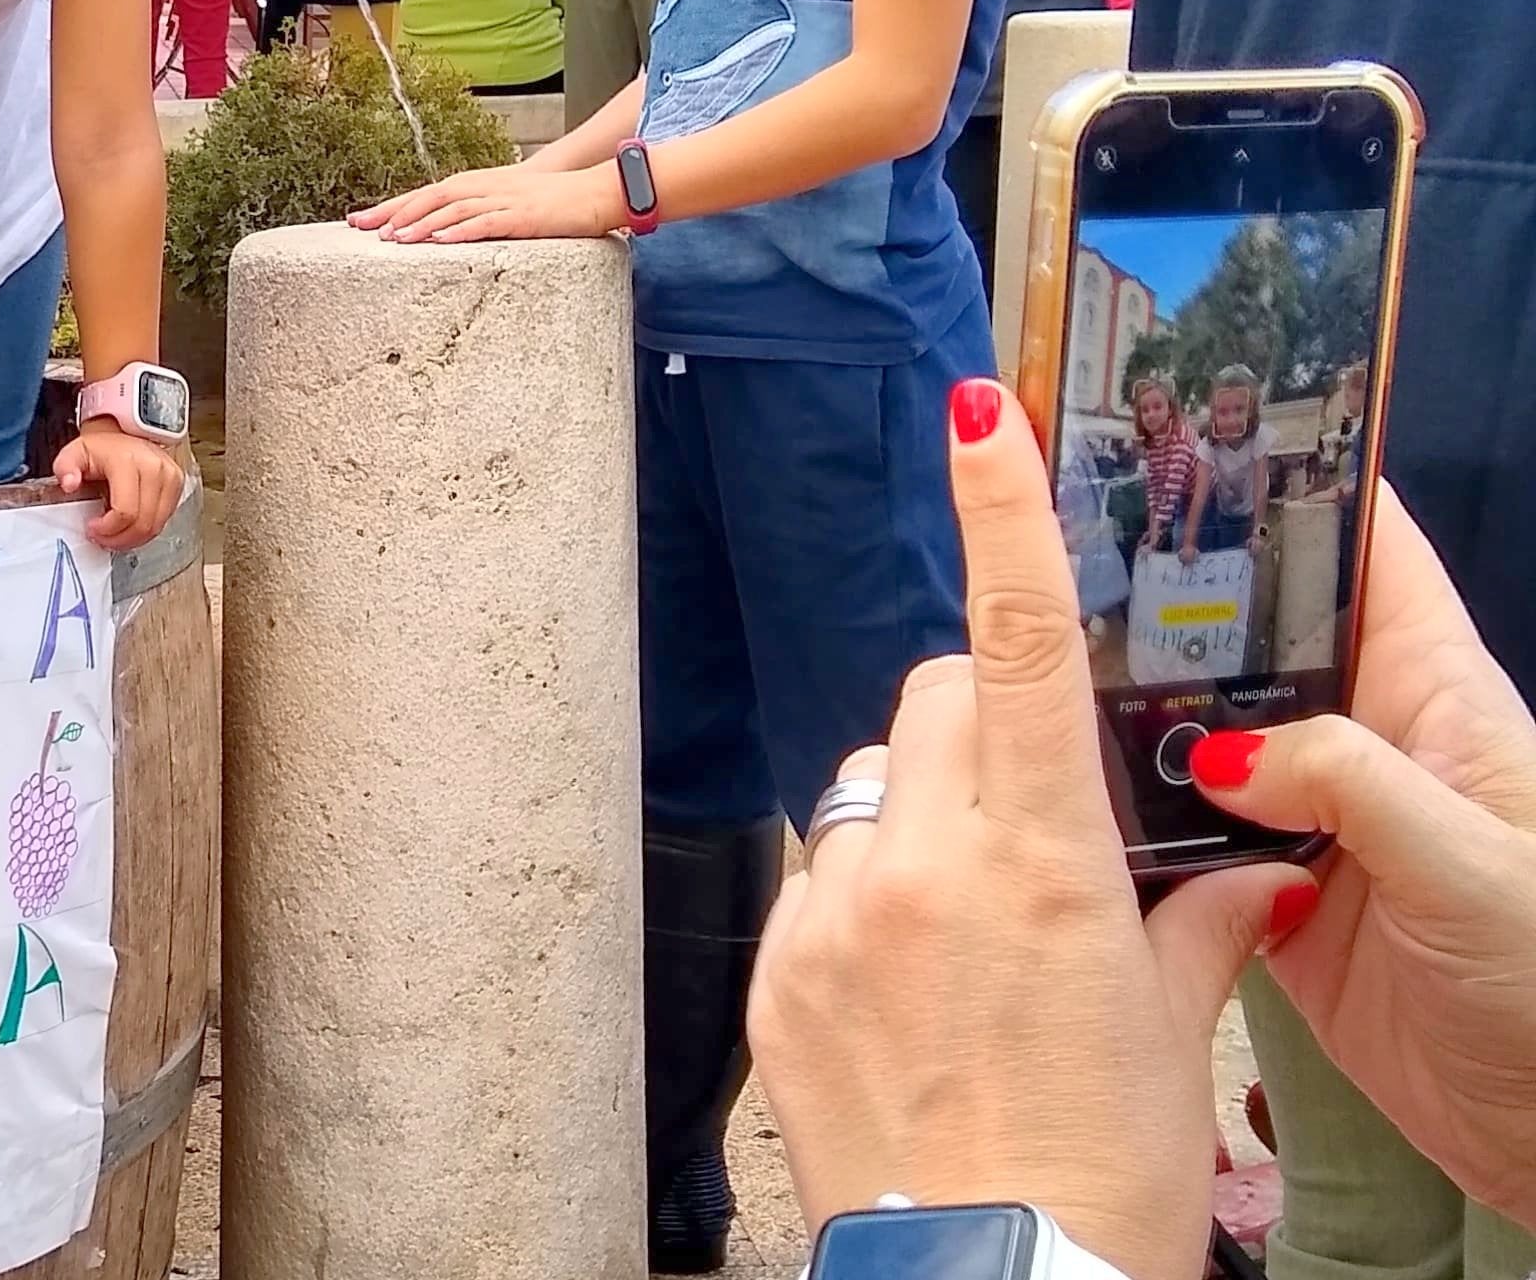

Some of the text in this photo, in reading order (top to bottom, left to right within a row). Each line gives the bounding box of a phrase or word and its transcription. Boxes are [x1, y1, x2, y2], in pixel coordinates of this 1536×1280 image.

[1119, 685, 1296, 713] FOTO RETRATO PANORÁMICA
